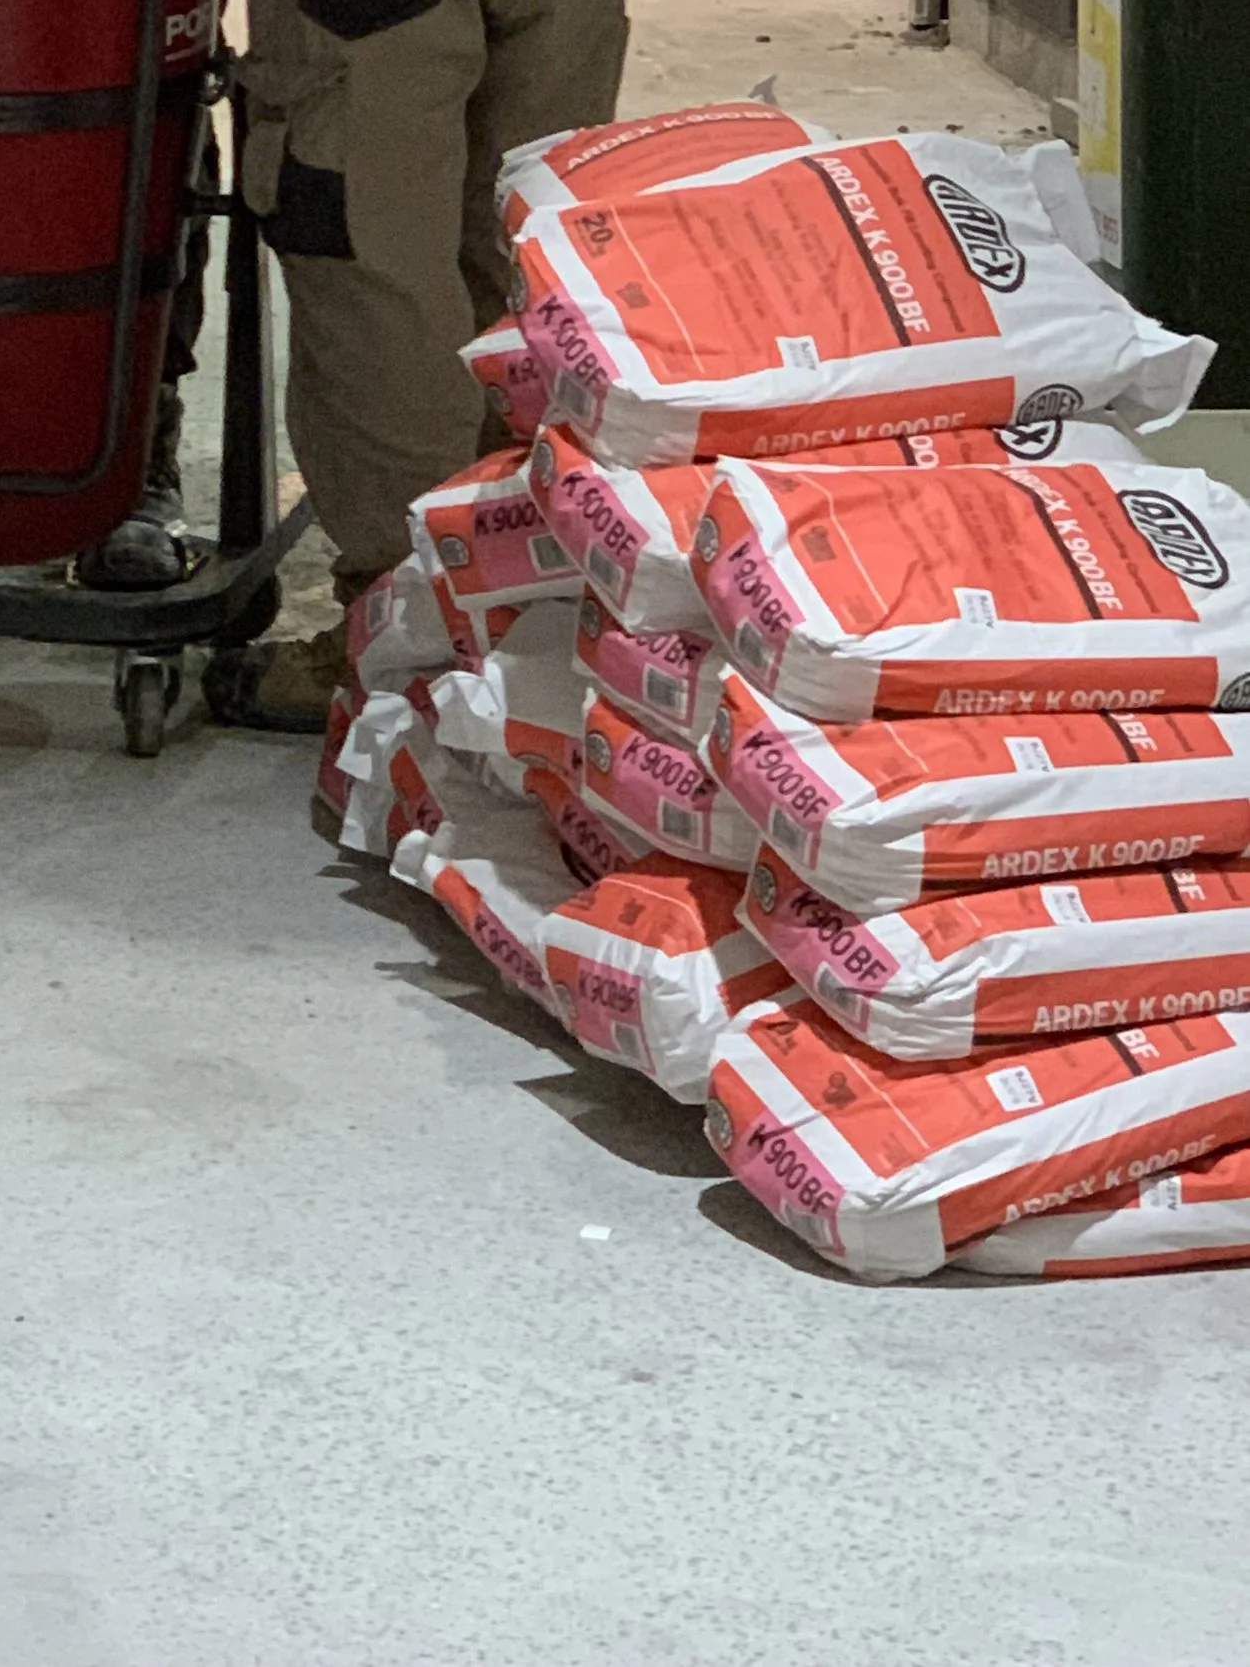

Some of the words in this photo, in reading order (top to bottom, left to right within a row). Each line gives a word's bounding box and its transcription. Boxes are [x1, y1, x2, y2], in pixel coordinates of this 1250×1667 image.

[815, 156, 880, 226] ARDEX
[862, 228, 892, 251] K
[935, 184, 1016, 279] ARDEX
[981, 846, 1080, 879] ARDEX
[1086, 844, 1110, 868] K
[1032, 999, 1129, 1034] ARDEX
